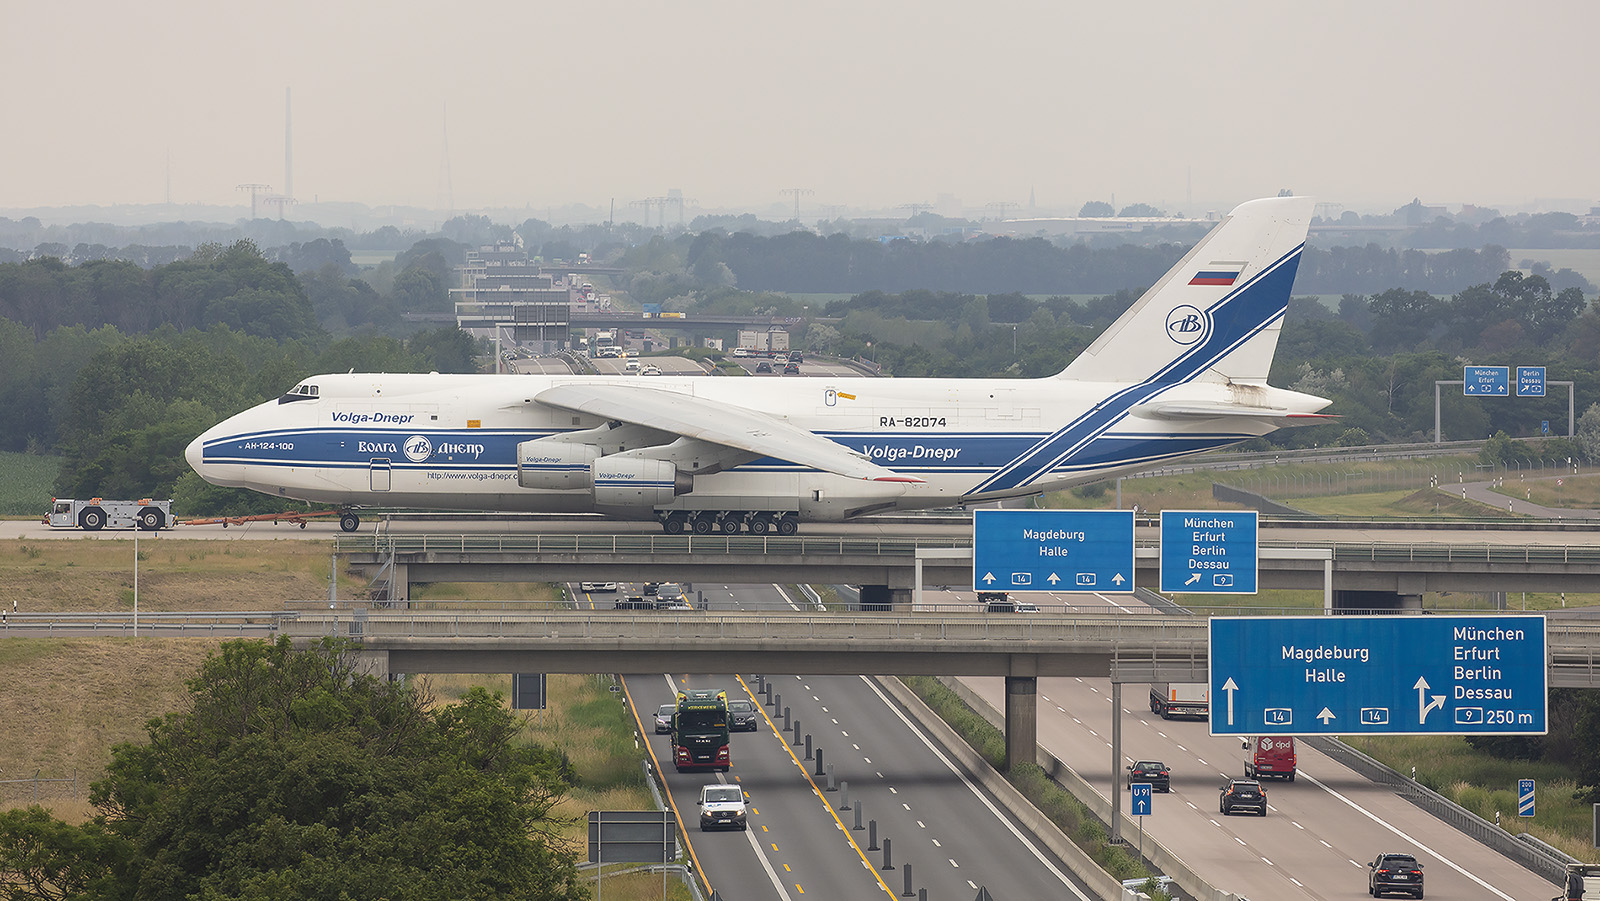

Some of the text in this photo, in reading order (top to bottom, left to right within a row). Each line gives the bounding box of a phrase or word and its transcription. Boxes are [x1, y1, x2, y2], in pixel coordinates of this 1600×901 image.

[331, 411, 414, 425] Volga-Dnepr
[879, 416, 947, 428] RA-82074
[863, 445, 962, 461] Volga-Dnepr
[525, 456, 562, 464] Volga-Dnepr
[598, 472, 635, 480] Volga-Dnepr
[1184, 517, 1234, 529] München
[1023, 529, 1085, 543] Magdeburg
[1192, 532, 1226, 542] Erfurt
[1039, 546, 1068, 557] Halle
[1192, 545, 1226, 556] Berlin
[1188, 559, 1230, 570] Dessau
[1017, 575, 1026, 583] 14
[1081, 575, 1091, 583] 14
[1220, 576, 1227, 584] 9
[1453, 626, 1525, 641] München
[1282, 645, 1370, 663] Magdeburg
[1454, 646, 1500, 661] Erfurt
[1305, 668, 1346, 683] Halle
[1454, 665, 1502, 680] Berlin
[1454, 685, 1513, 700] Dessau
[1272, 711, 1284, 721] 14
[1368, 711, 1380, 721] 14
[1465, 711, 1472, 721] 9
[1486, 710, 1533, 724] 250 m
[1275, 740, 1291, 749] dpd
[1133, 788, 1150, 796] U 91
